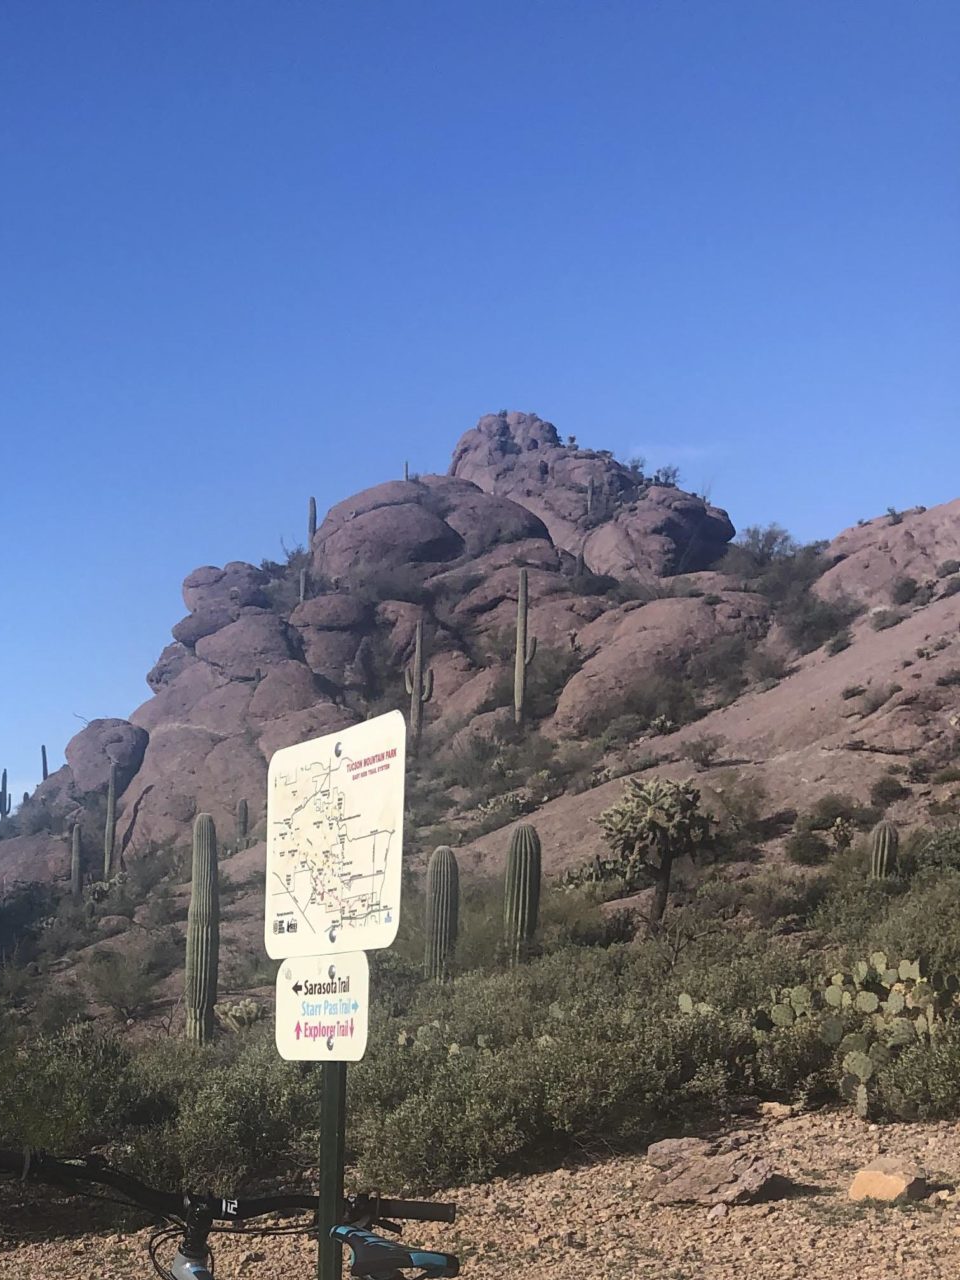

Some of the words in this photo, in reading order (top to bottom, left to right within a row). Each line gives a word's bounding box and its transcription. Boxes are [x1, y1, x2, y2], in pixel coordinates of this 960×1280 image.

[347, 760, 362, 773] TUCSON
[364, 752, 385, 767] MOUNTAIN
[386, 748, 397, 759] PARK
[304, 979, 337, 996] Sarasota
[337, 975, 350, 993] Trail
[301, 1001, 322, 1016] Starr
[323, 999, 338, 1015] Pass
[338, 997, 351, 1014] Trail
[304, 1021, 336, 1042] Explorer
[336, 1020, 349, 1037] Trail
